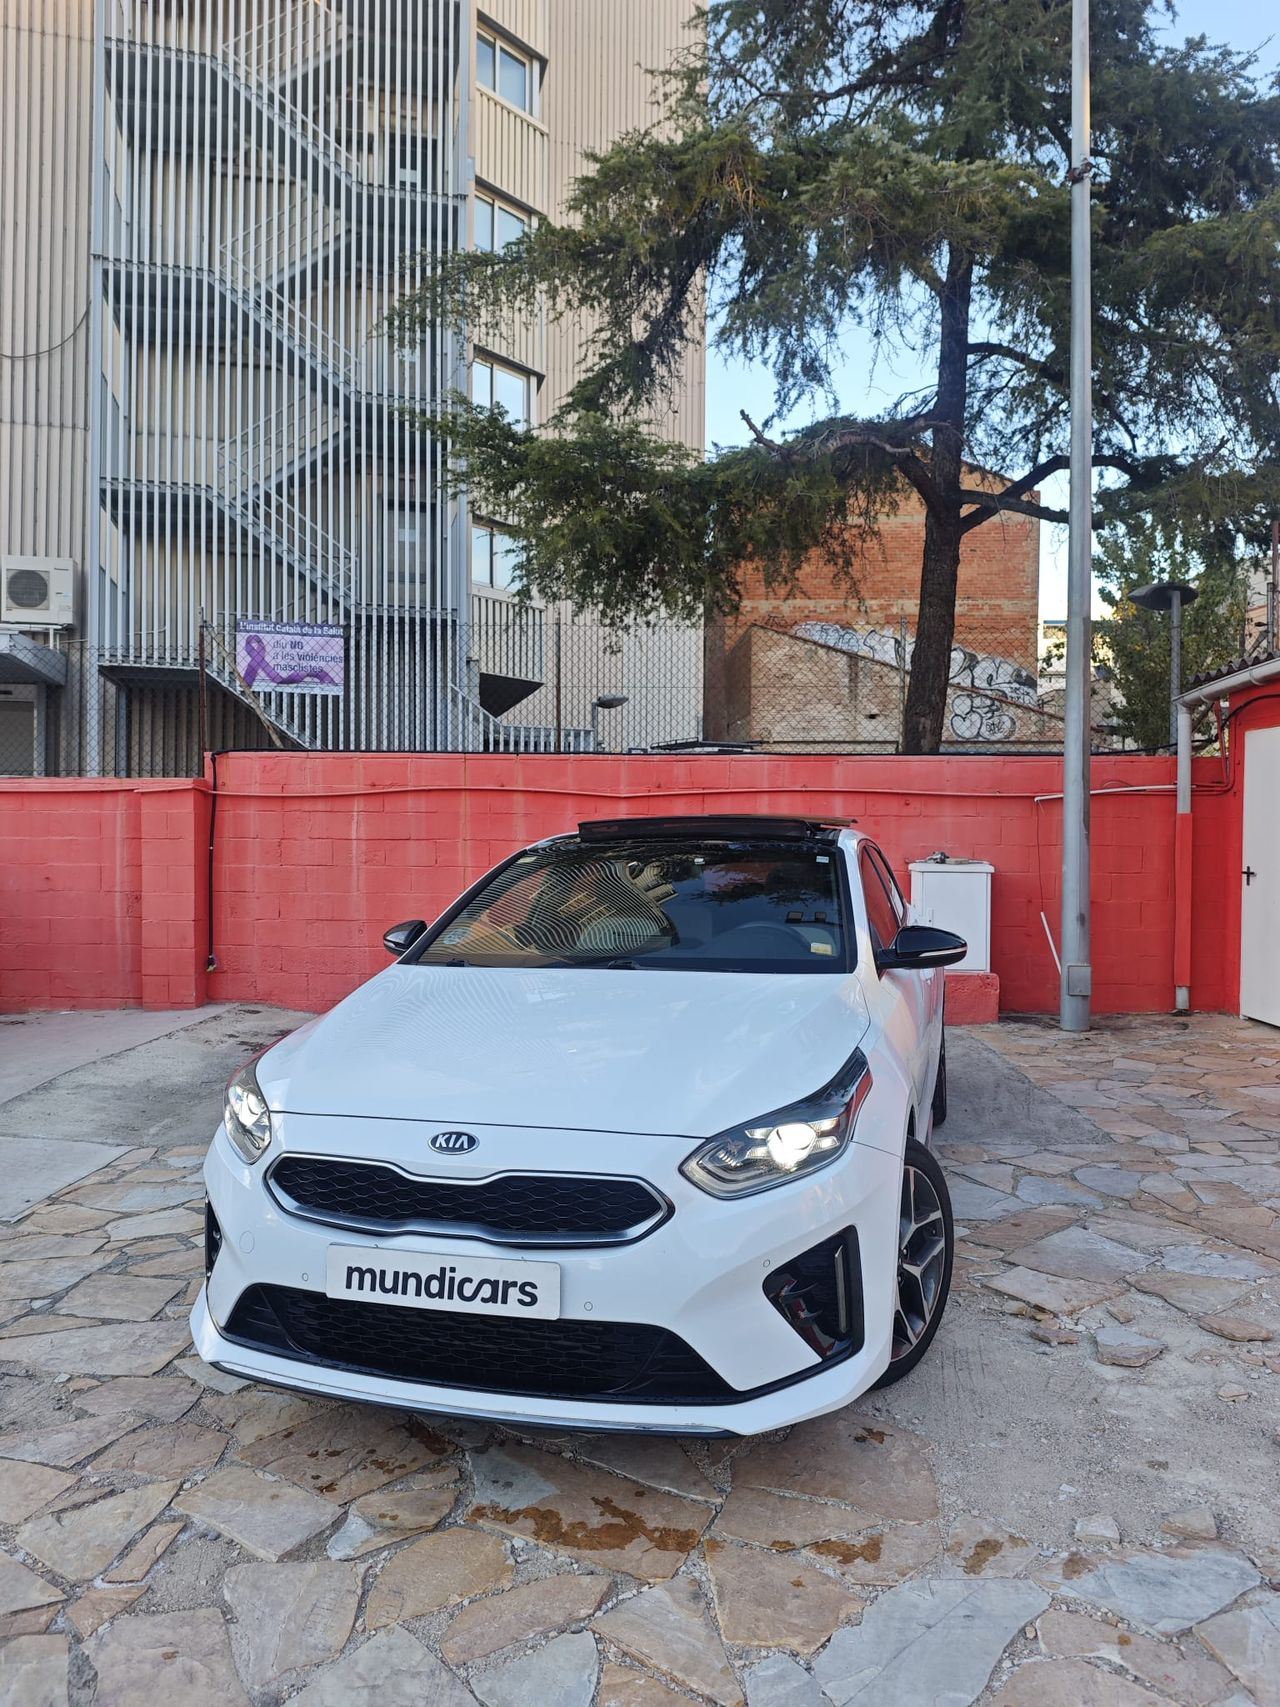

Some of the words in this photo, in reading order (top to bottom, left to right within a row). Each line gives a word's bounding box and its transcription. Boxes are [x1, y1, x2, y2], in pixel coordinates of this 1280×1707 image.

[314, 627, 322, 635] la
[323, 627, 344, 636] Salut
[273, 640, 287, 649] diu
[290, 640, 304, 650] NO
[281, 652, 295, 661] les
[273, 663, 323, 673] masclistes
[435, 1134, 469, 1149] KIA
[345, 1266, 538, 1307] mundicars
